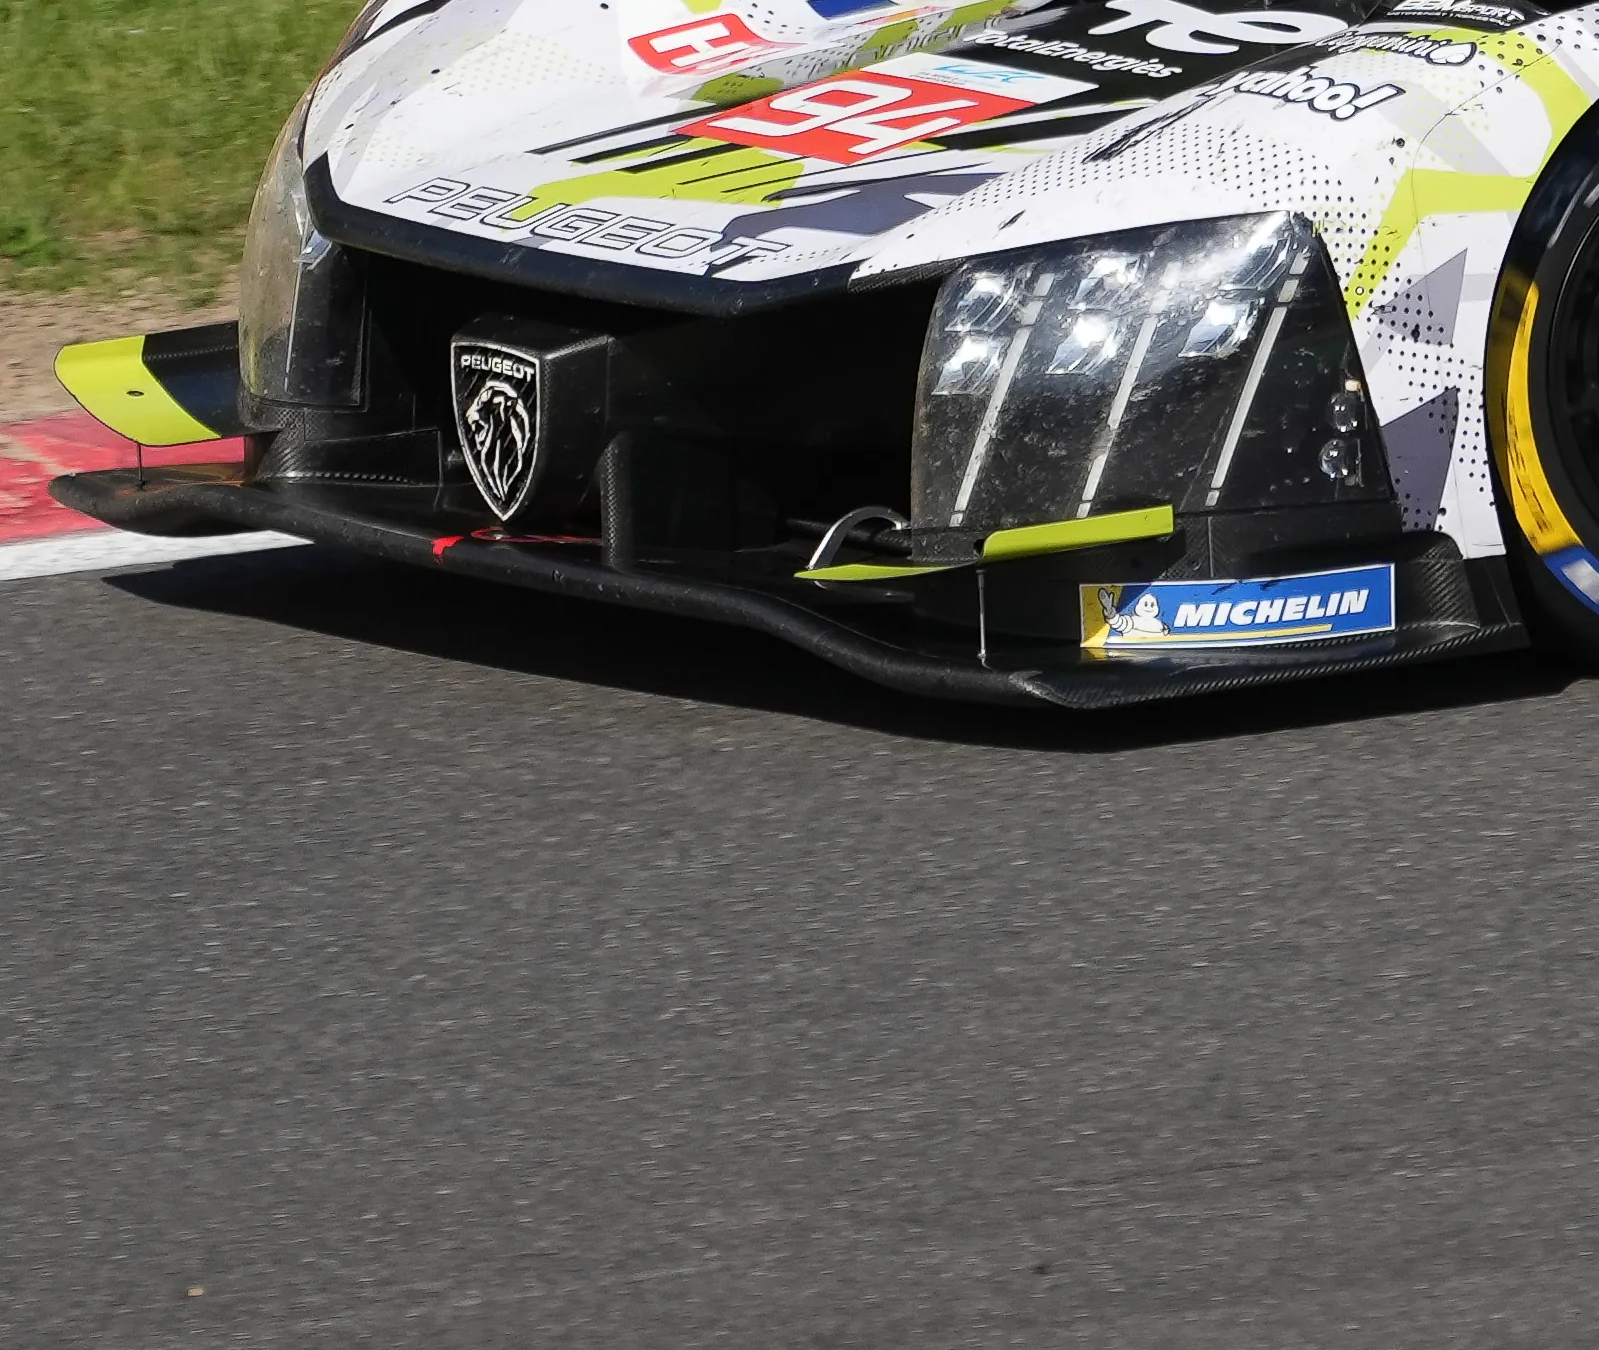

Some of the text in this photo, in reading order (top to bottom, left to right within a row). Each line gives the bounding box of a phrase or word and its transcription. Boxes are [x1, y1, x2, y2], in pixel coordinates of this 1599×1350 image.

[962, 28, 1183, 79] TotalEnergies
[706, 79, 980, 154] 94
[383, 177, 793, 267] PEUGEOT
[460, 354, 535, 382] PEUGEOT
[1173, 589, 1370, 628] MICHELIN
